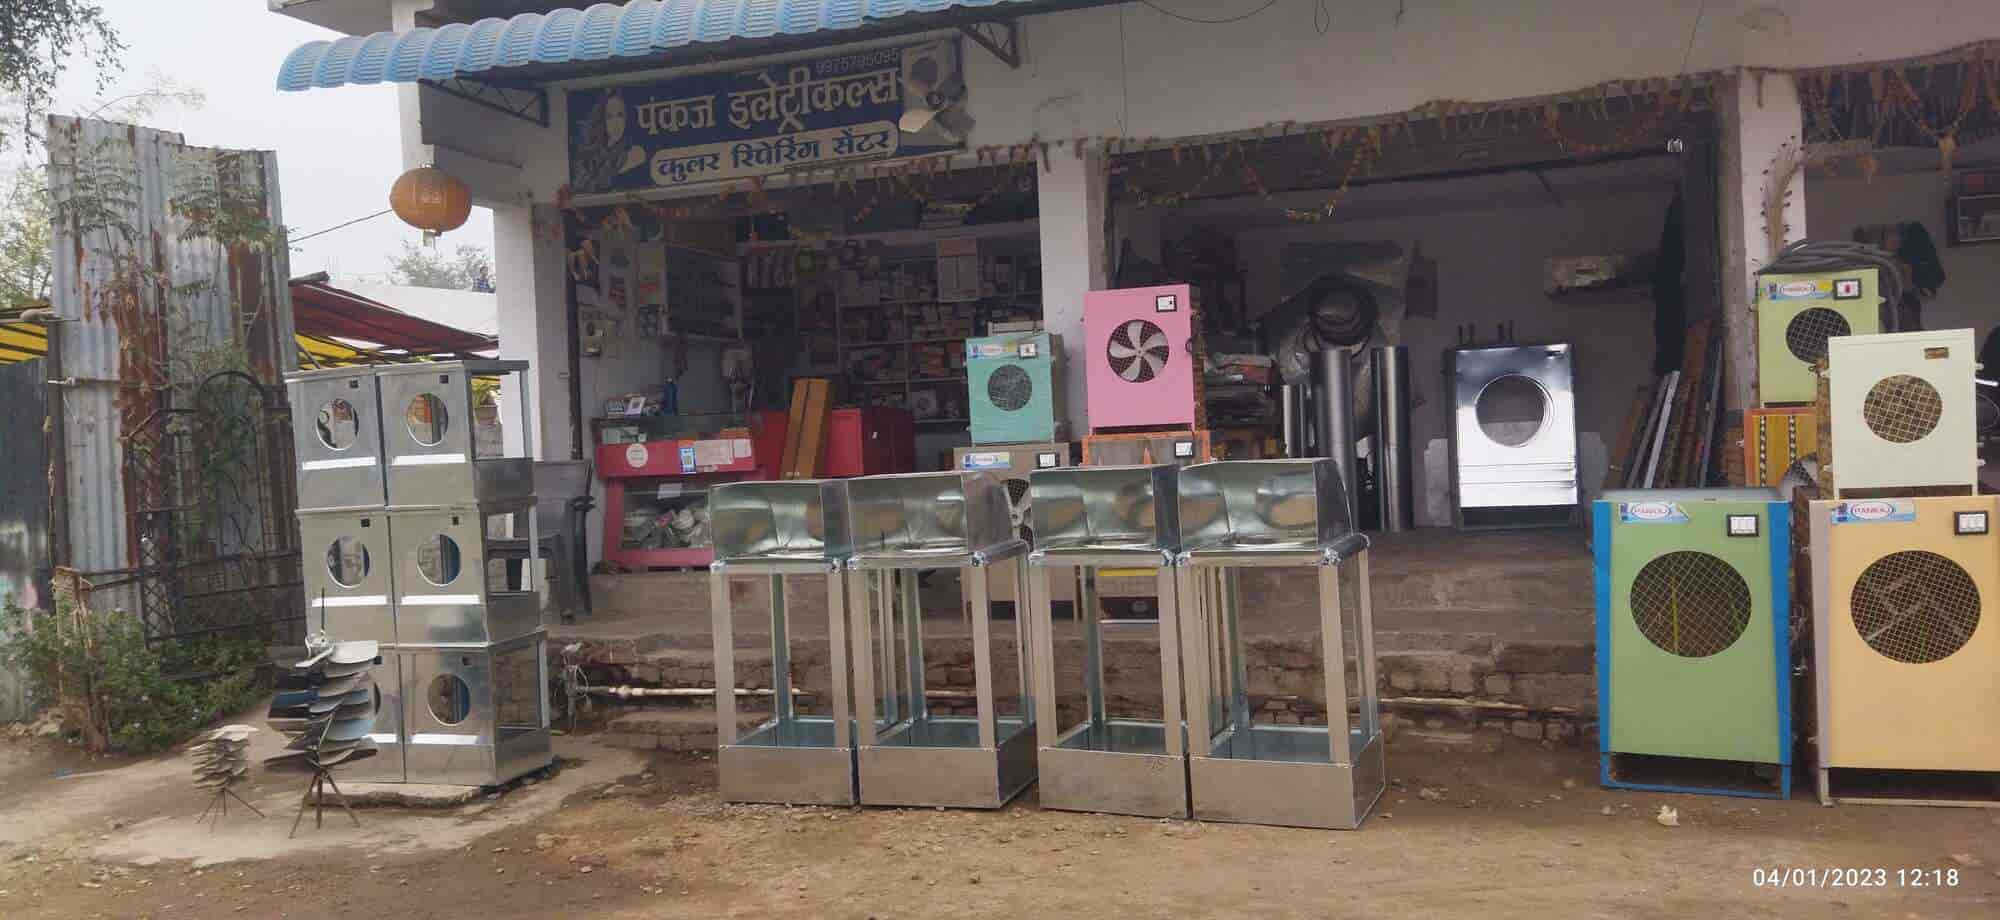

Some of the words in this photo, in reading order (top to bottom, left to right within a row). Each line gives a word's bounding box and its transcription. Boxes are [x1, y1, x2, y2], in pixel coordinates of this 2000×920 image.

[636, 96, 716, 135] पंकज
[658, 152, 720, 182] कुलर
[832, 127, 890, 154] सेंटर
